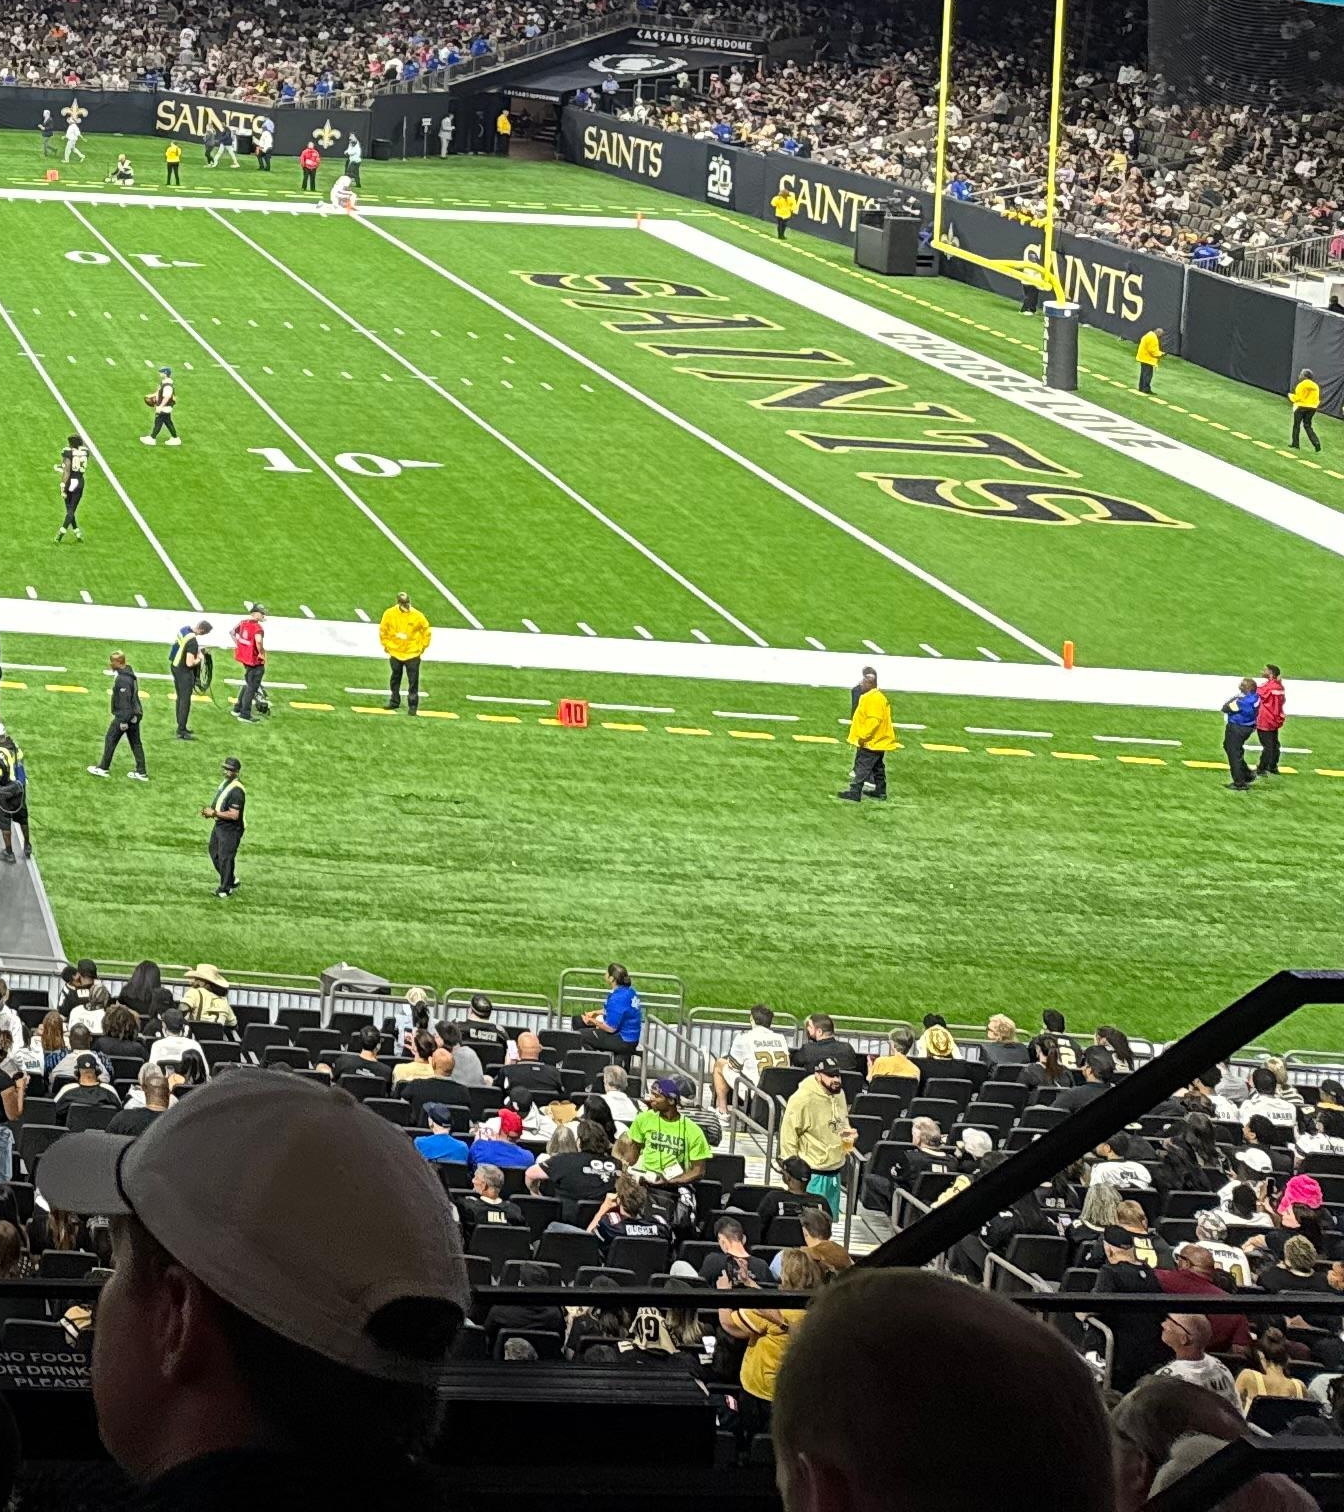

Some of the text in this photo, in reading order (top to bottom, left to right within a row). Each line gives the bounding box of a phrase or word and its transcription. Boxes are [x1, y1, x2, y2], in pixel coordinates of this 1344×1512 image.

[689, 36, 753, 52] SUPERDOME
[583, 125, 663, 178] SAINTS
[512, 271, 1194, 530] SAINTS
[1025, 399, 1183, 450] LOVE
[246, 447, 402, 479] 10
[564, 702, 585, 724] 10
[30, 1352, 87, 1364] FOOD
[27, 1365, 91, 1378] DRINK
[14, 1377, 93, 1389] PLEASE
